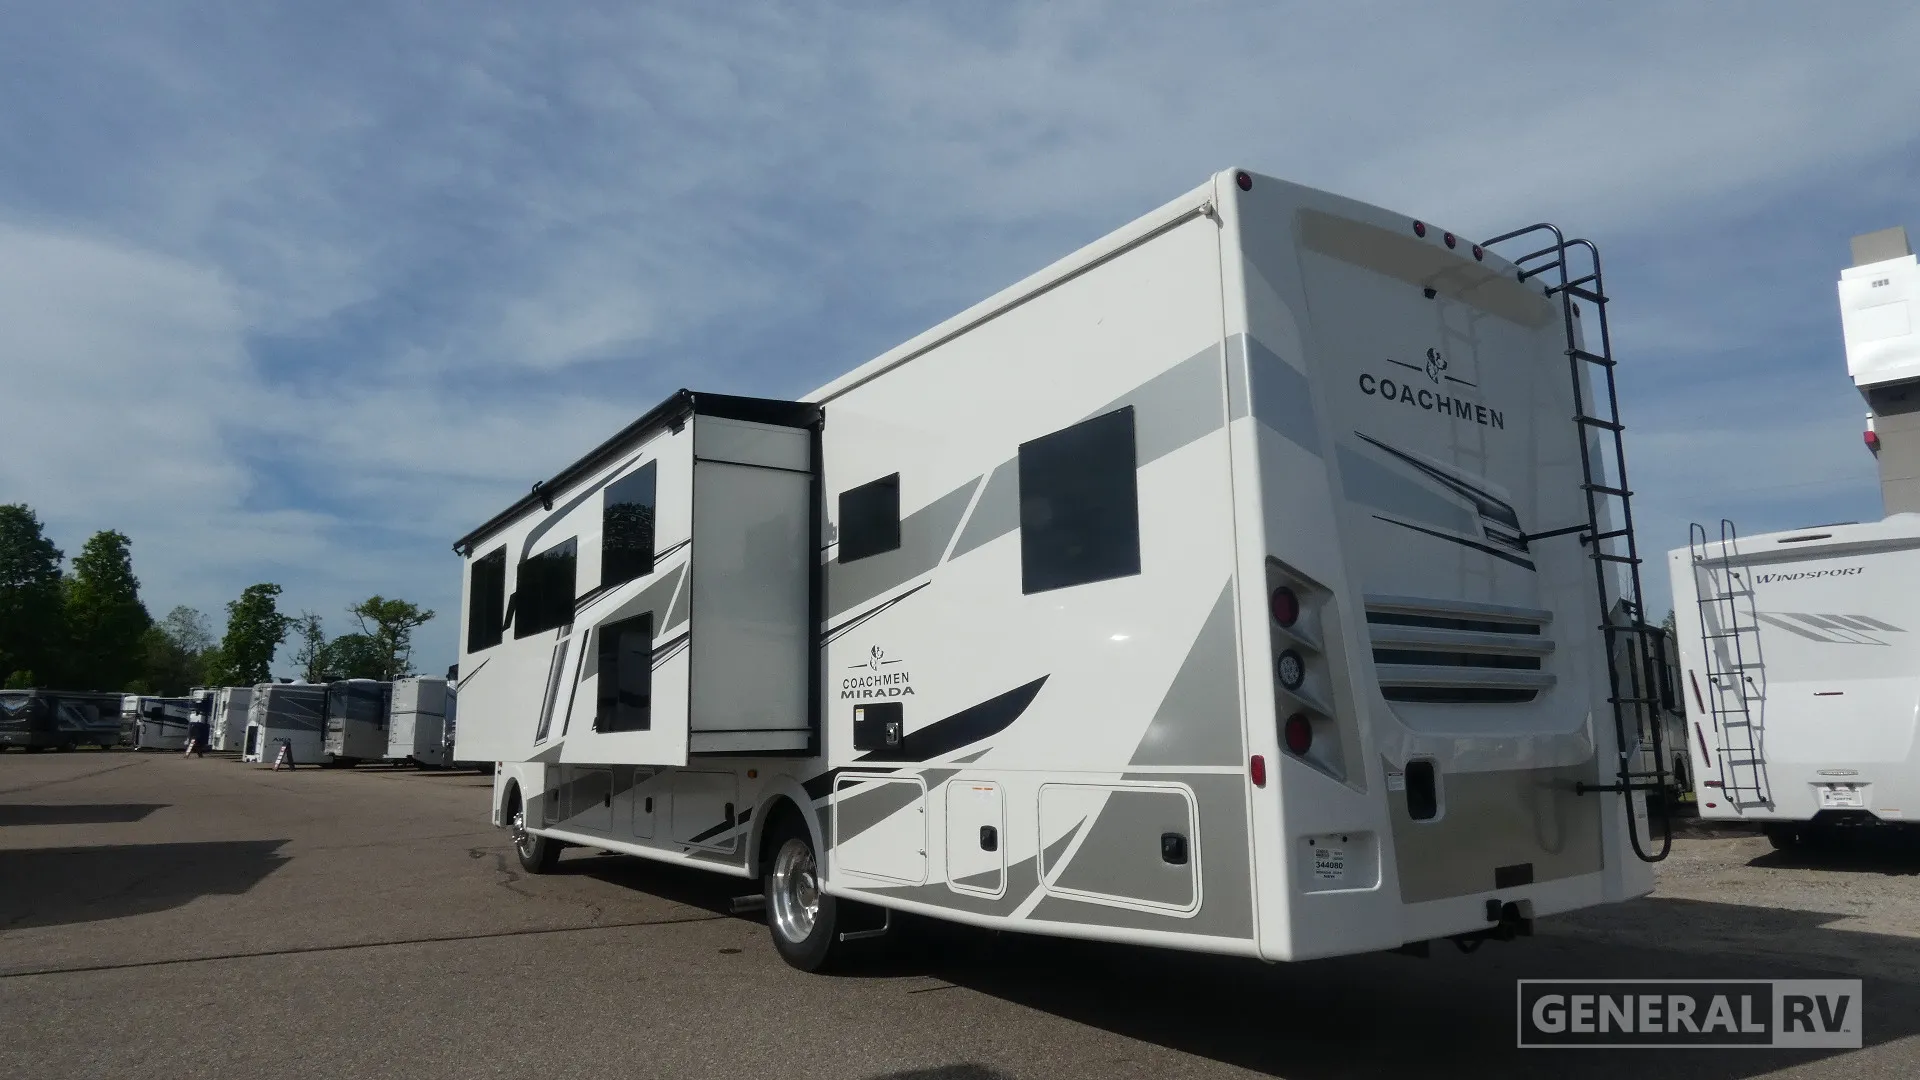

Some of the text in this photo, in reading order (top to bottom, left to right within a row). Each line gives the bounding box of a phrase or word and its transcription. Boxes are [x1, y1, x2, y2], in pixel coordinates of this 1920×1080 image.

[1359, 373, 1504, 429] COACHMEN
[1756, 566, 1864, 584] WINDSPORT
[842, 672, 909, 689] COACHMEN
[841, 686, 915, 699] MIRADA
[1315, 861, 1343, 869] 344080
